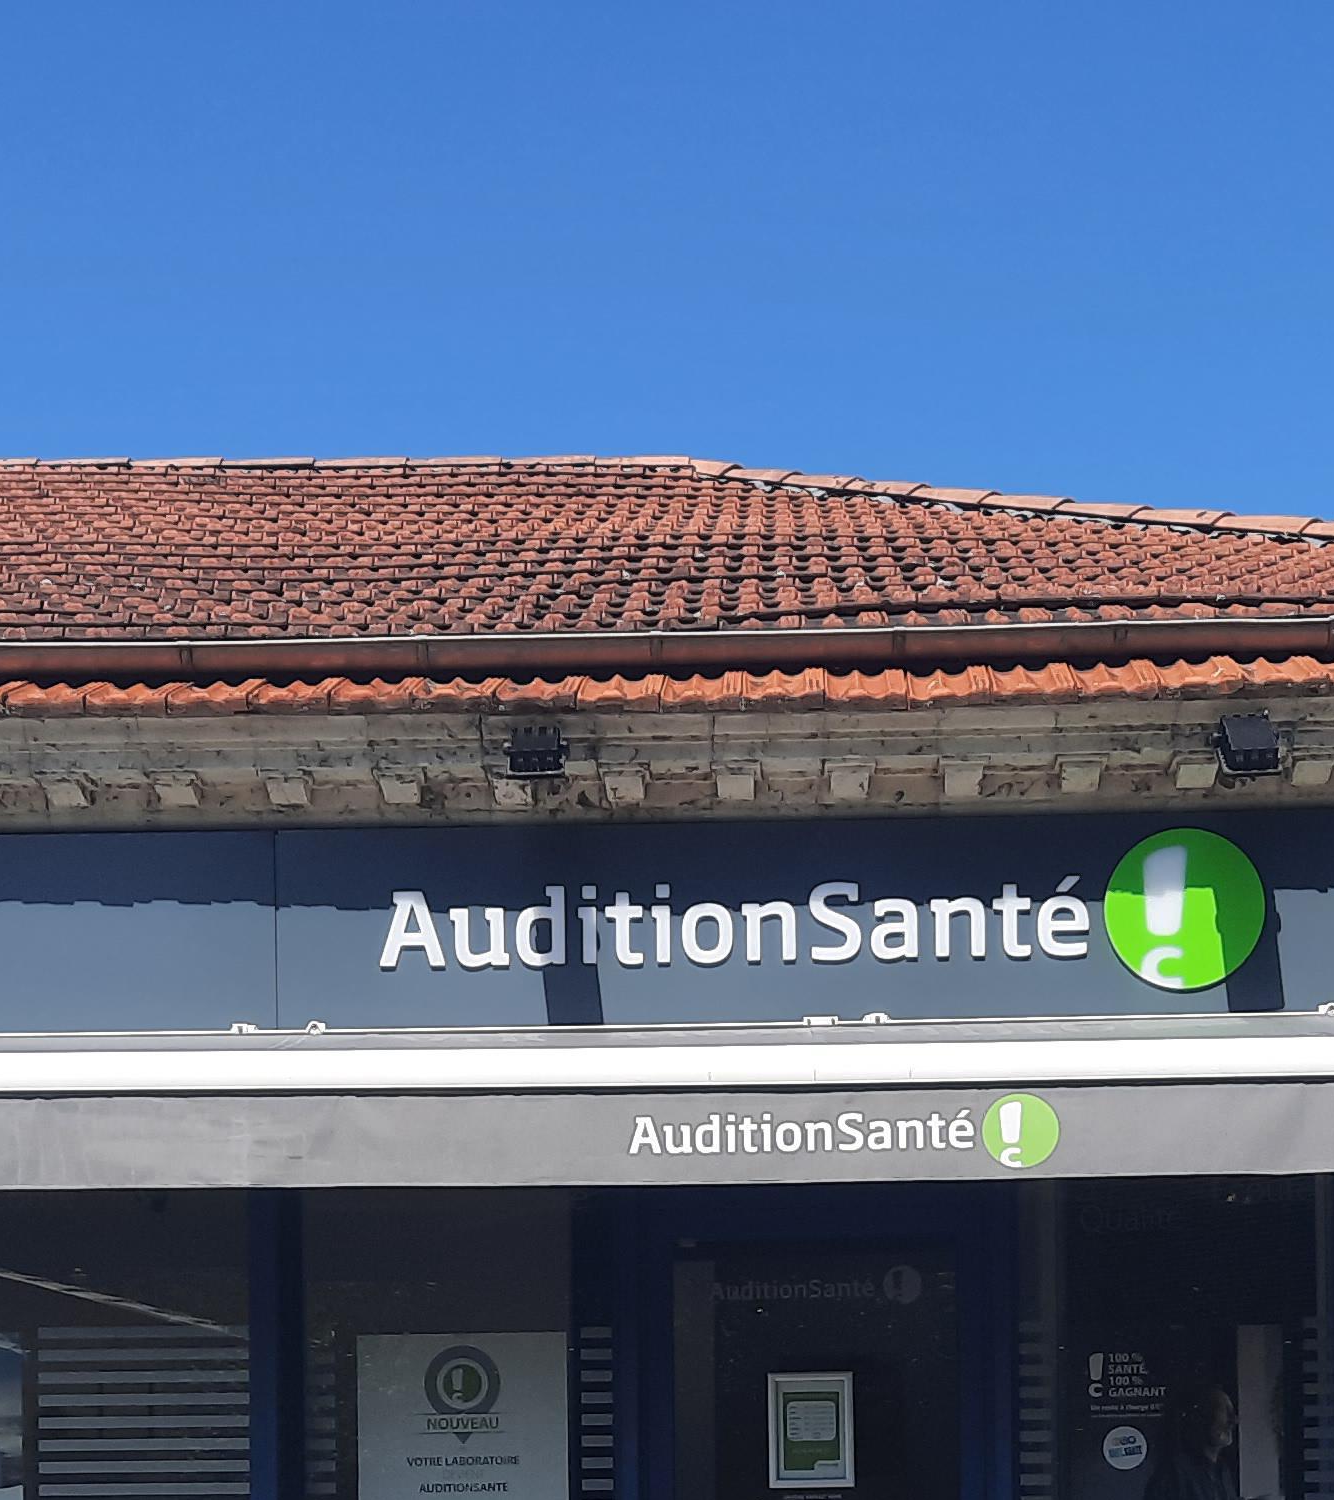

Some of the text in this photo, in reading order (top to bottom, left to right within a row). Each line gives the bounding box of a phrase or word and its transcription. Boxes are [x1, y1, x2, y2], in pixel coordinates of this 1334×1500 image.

[379, 874, 1091, 971] AuditionSanté
[629, 1109, 974, 1154] AuditionSanté
[711, 1278, 875, 1301] AuditionSanté
[1108, 1353, 1129, 1363] 100
[1109, 1376, 1130, 1386] 100
[1108, 1386, 1167, 1397] GAGNANT
[427, 1417, 499, 1430] NOUVEAU
[407, 1455, 519, 1467] VOTRE LABORATOIRE
